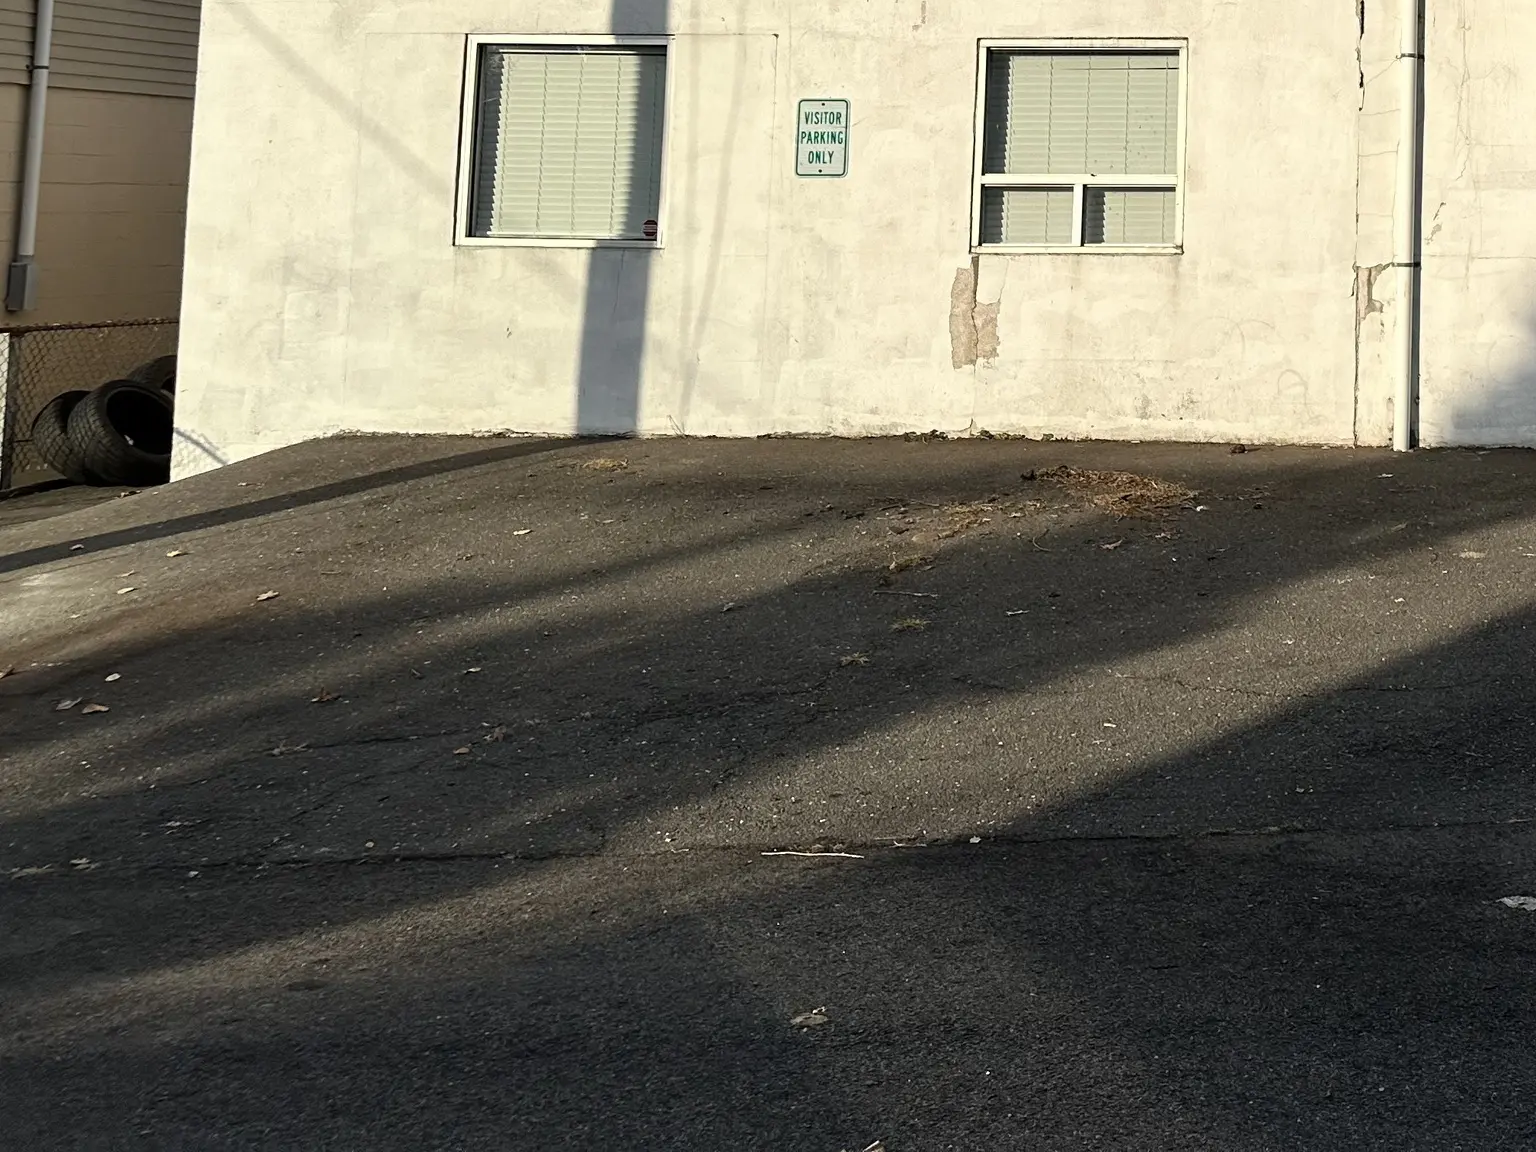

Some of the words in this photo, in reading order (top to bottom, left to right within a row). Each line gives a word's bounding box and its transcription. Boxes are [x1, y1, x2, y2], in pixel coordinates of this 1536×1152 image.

[804, 111, 842, 125] VISITOR
[800, 131, 844, 145] PARKING
[807, 150, 835, 165] ONLY
